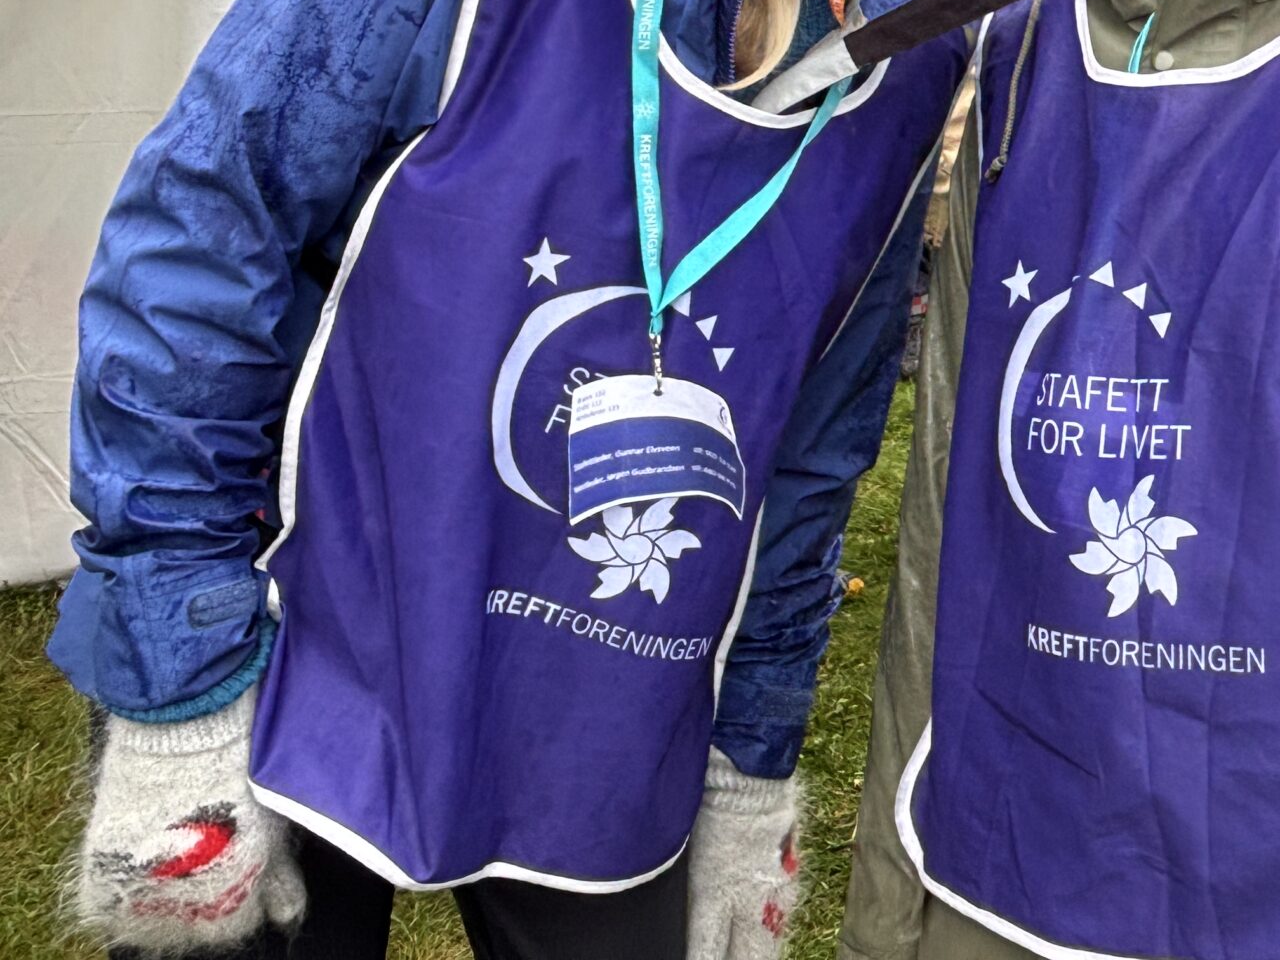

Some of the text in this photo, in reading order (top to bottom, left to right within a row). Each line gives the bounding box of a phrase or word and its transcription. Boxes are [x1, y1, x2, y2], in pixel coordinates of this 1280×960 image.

[638, 133, 660, 268] KREFTFORENINGEN
[1036, 373, 1170, 413] STAFETT
[1027, 417, 1192, 461] FOR LIVET
[1027, 623, 1266, 674] KREFTFORENINGEN
